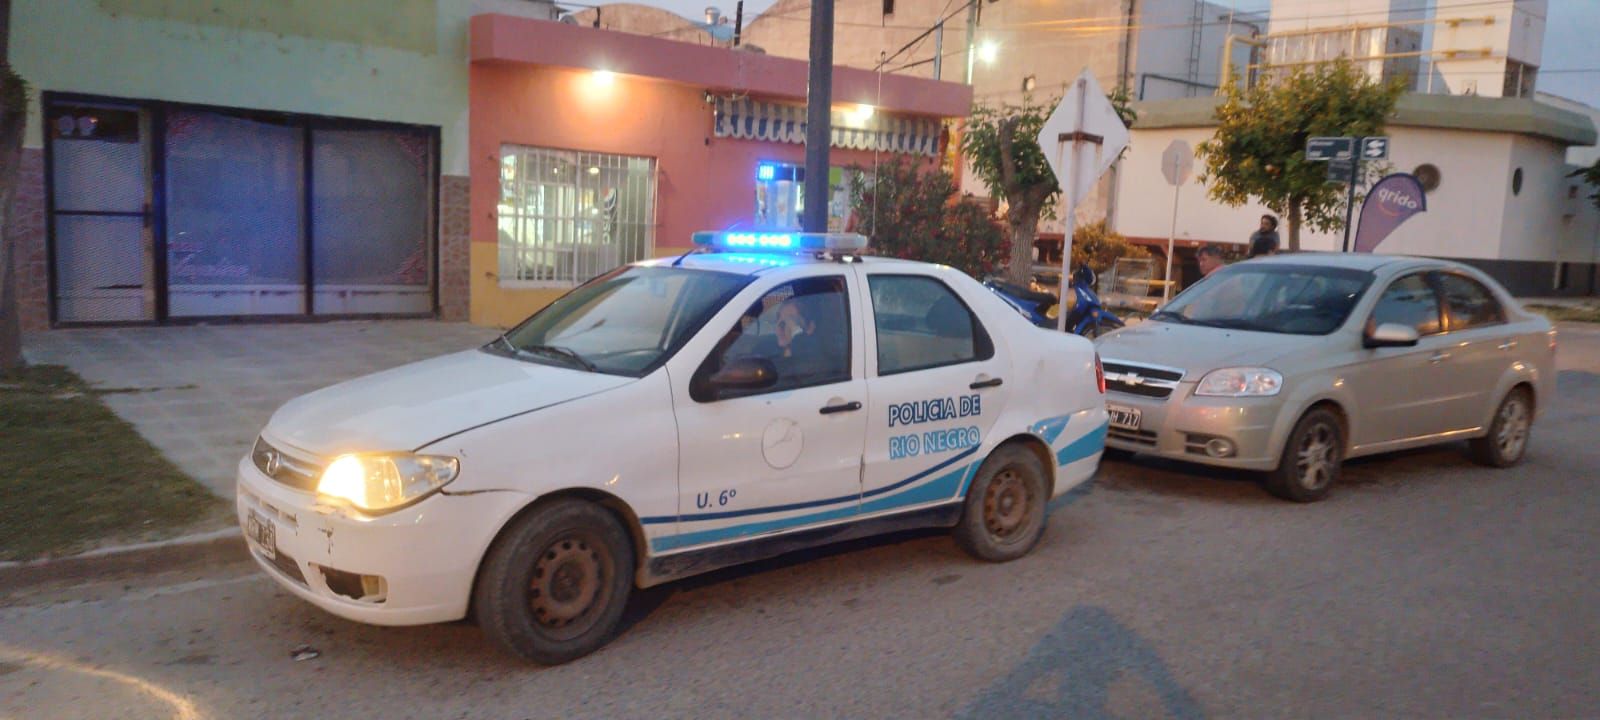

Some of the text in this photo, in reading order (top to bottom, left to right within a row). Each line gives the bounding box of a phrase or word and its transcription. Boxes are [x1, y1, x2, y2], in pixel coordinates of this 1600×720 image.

[1379, 188, 1417, 208] grido
[888, 394, 981, 428] POLICIA DE
[1122, 411, 1139, 427] 717
[889, 426, 981, 460] RIO NEGRO
[697, 492, 712, 509] U.
